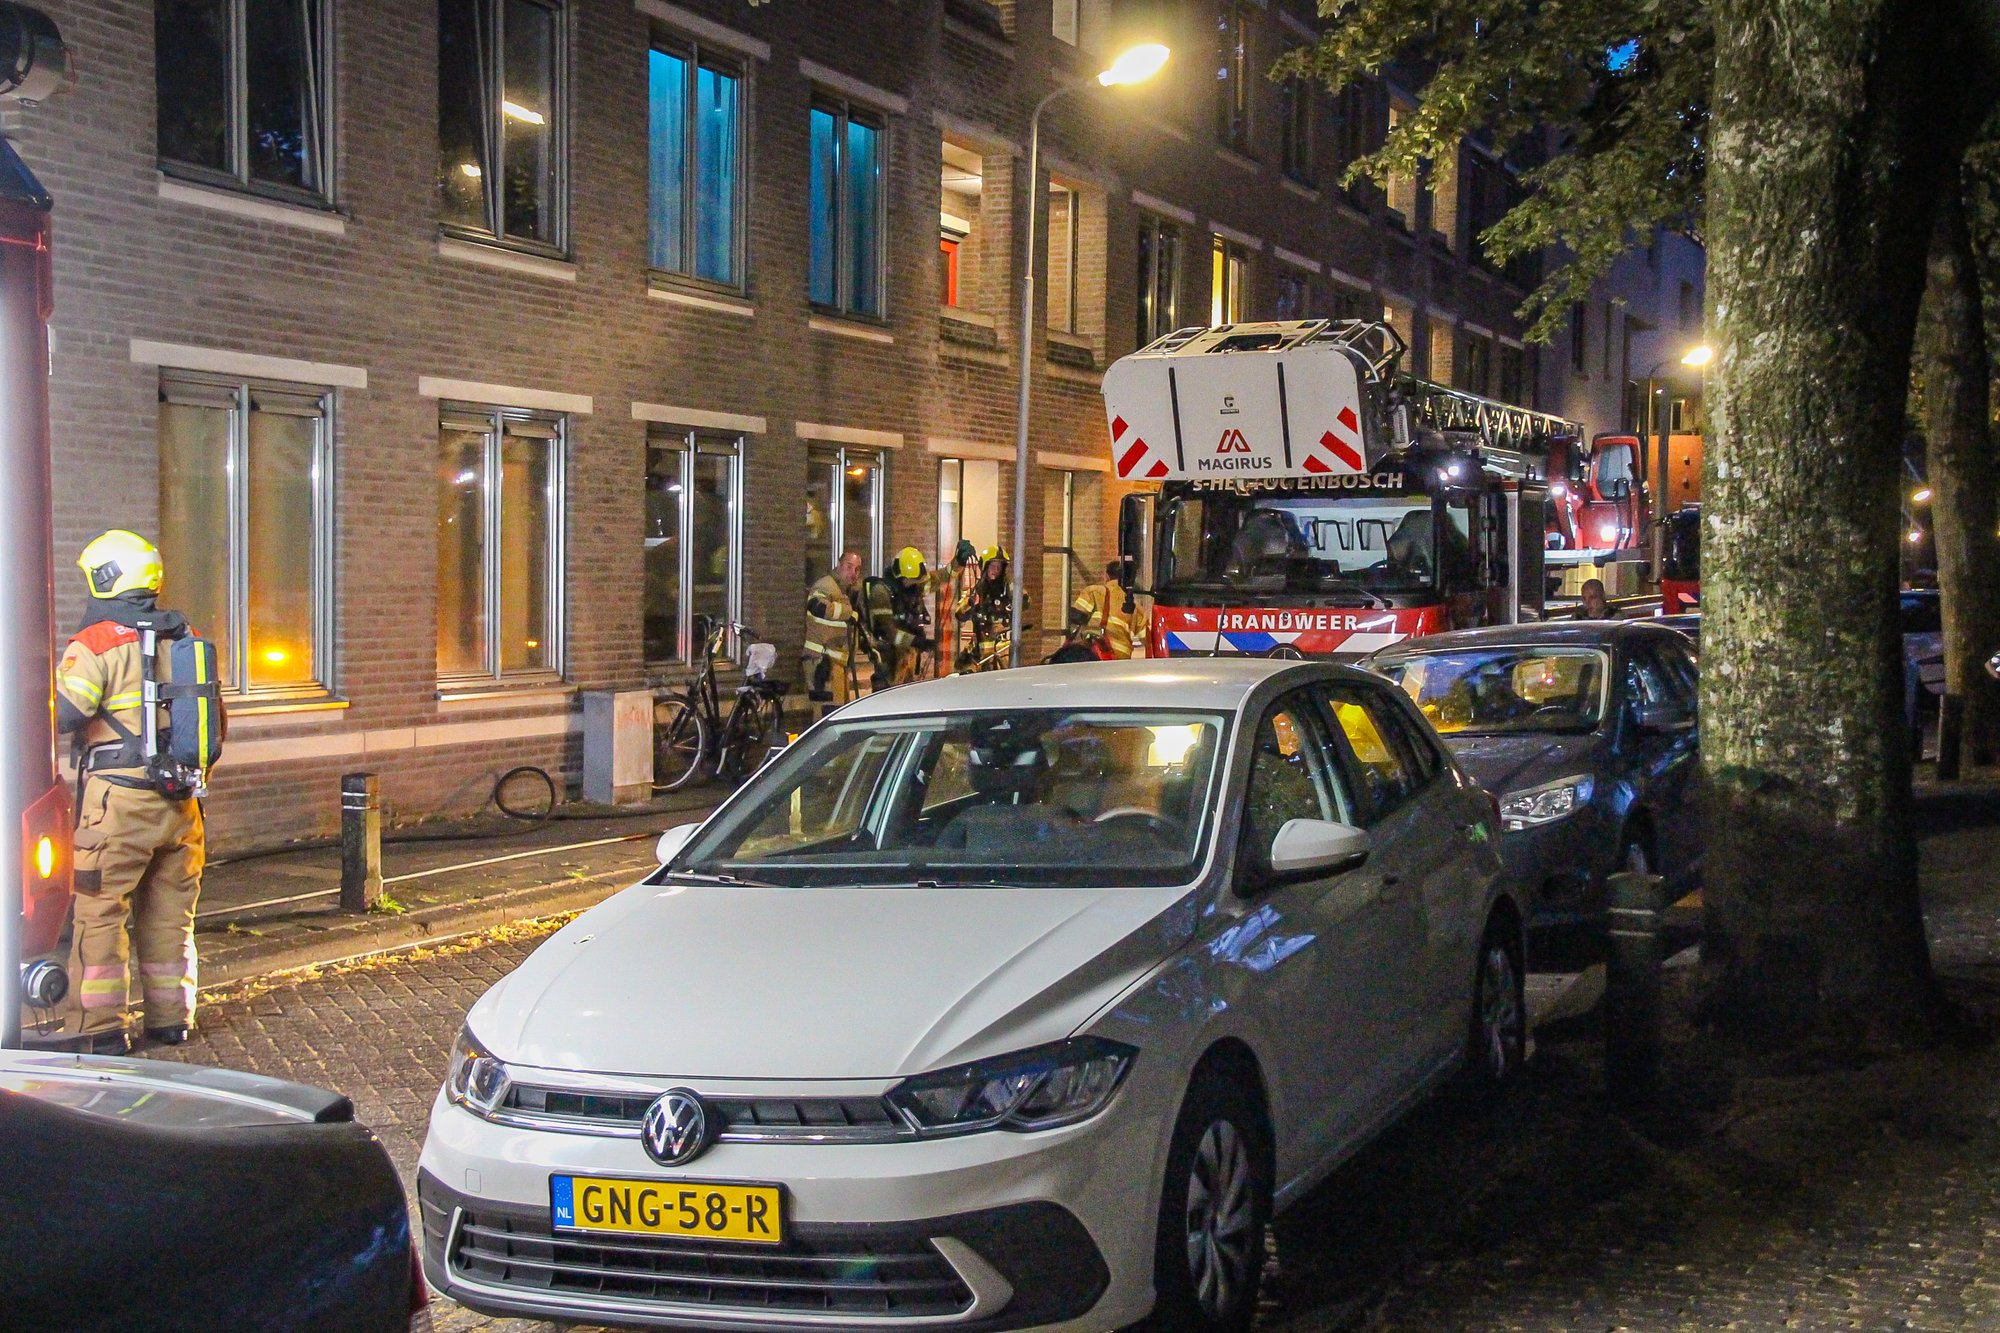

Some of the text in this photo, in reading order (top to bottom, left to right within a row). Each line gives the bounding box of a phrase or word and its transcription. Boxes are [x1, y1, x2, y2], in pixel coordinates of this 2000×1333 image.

[1198, 457, 1272, 470] MAGIRUS
[1217, 613, 1357, 630] BRANDWEER
[557, 1206, 572, 1219] NL
[582, 1185, 770, 1234] GNG-58-R
